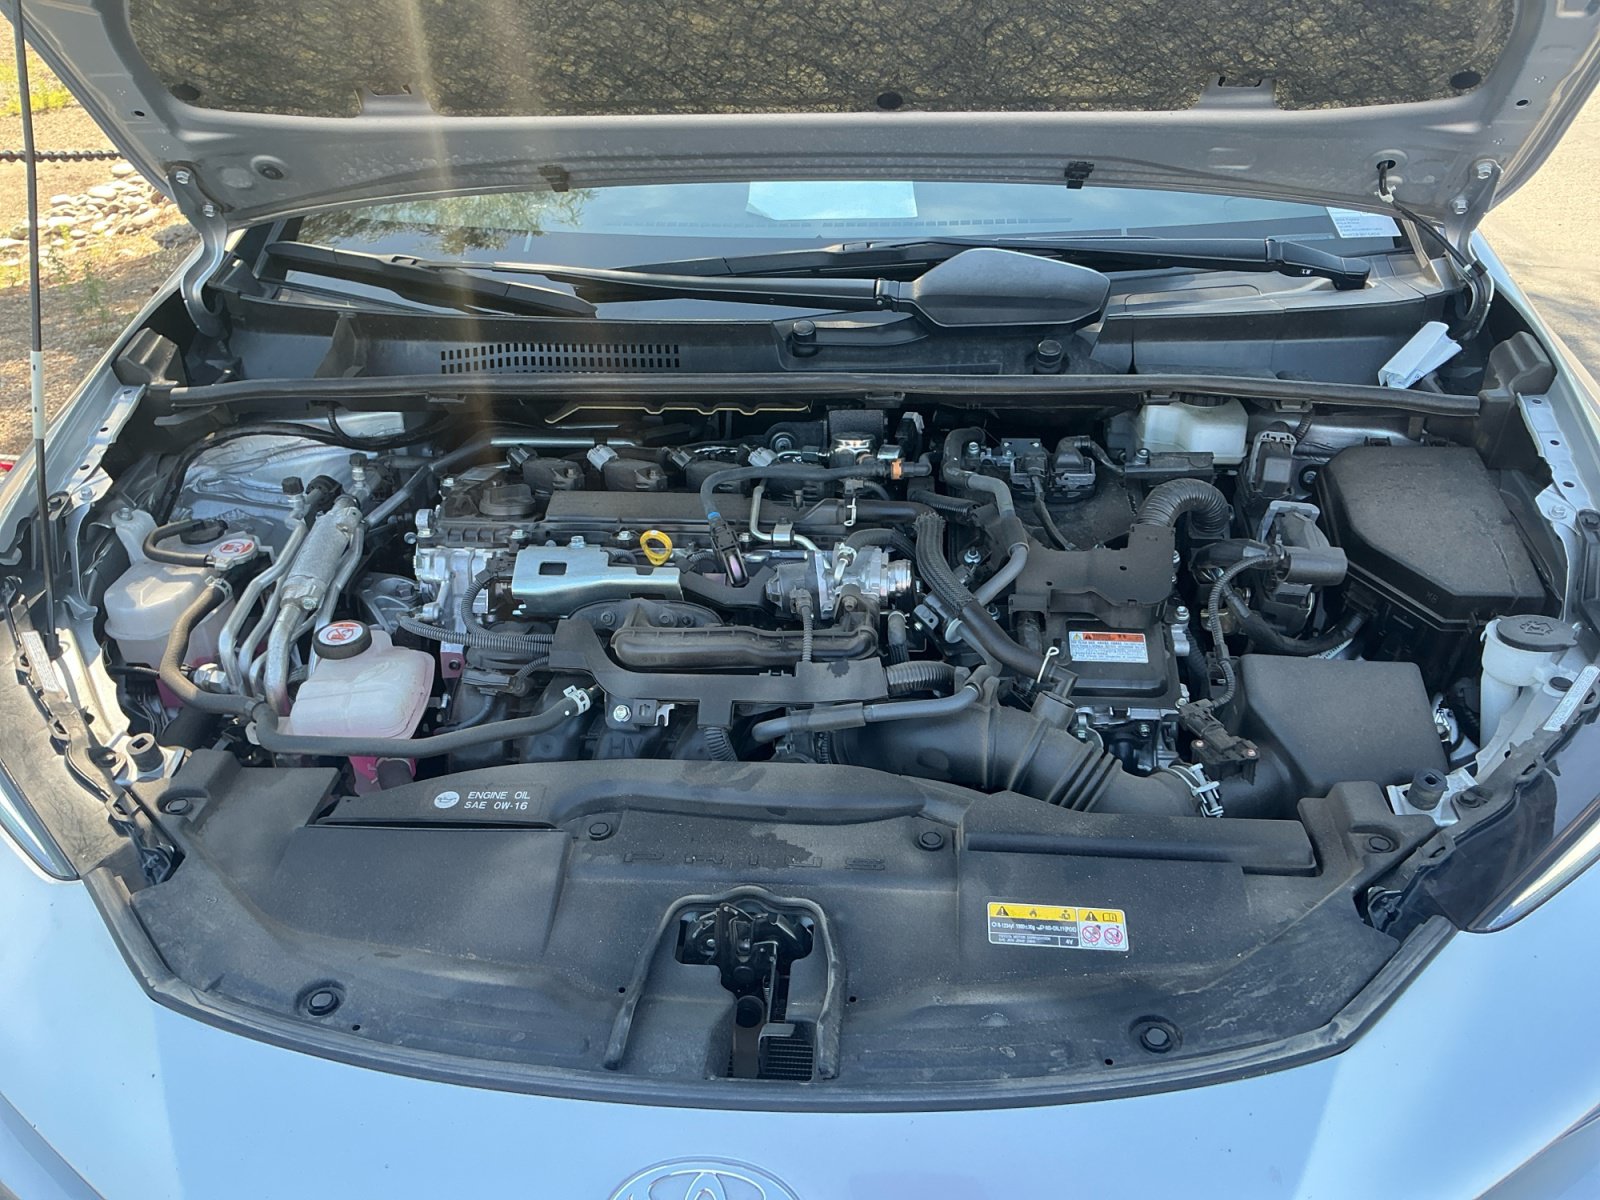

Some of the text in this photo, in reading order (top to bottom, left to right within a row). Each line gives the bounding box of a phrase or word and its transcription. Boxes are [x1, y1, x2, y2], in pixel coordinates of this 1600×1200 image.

[467, 791, 530, 800] ENGINE OIL
[463, 801, 529, 810] SAE 0W-16
